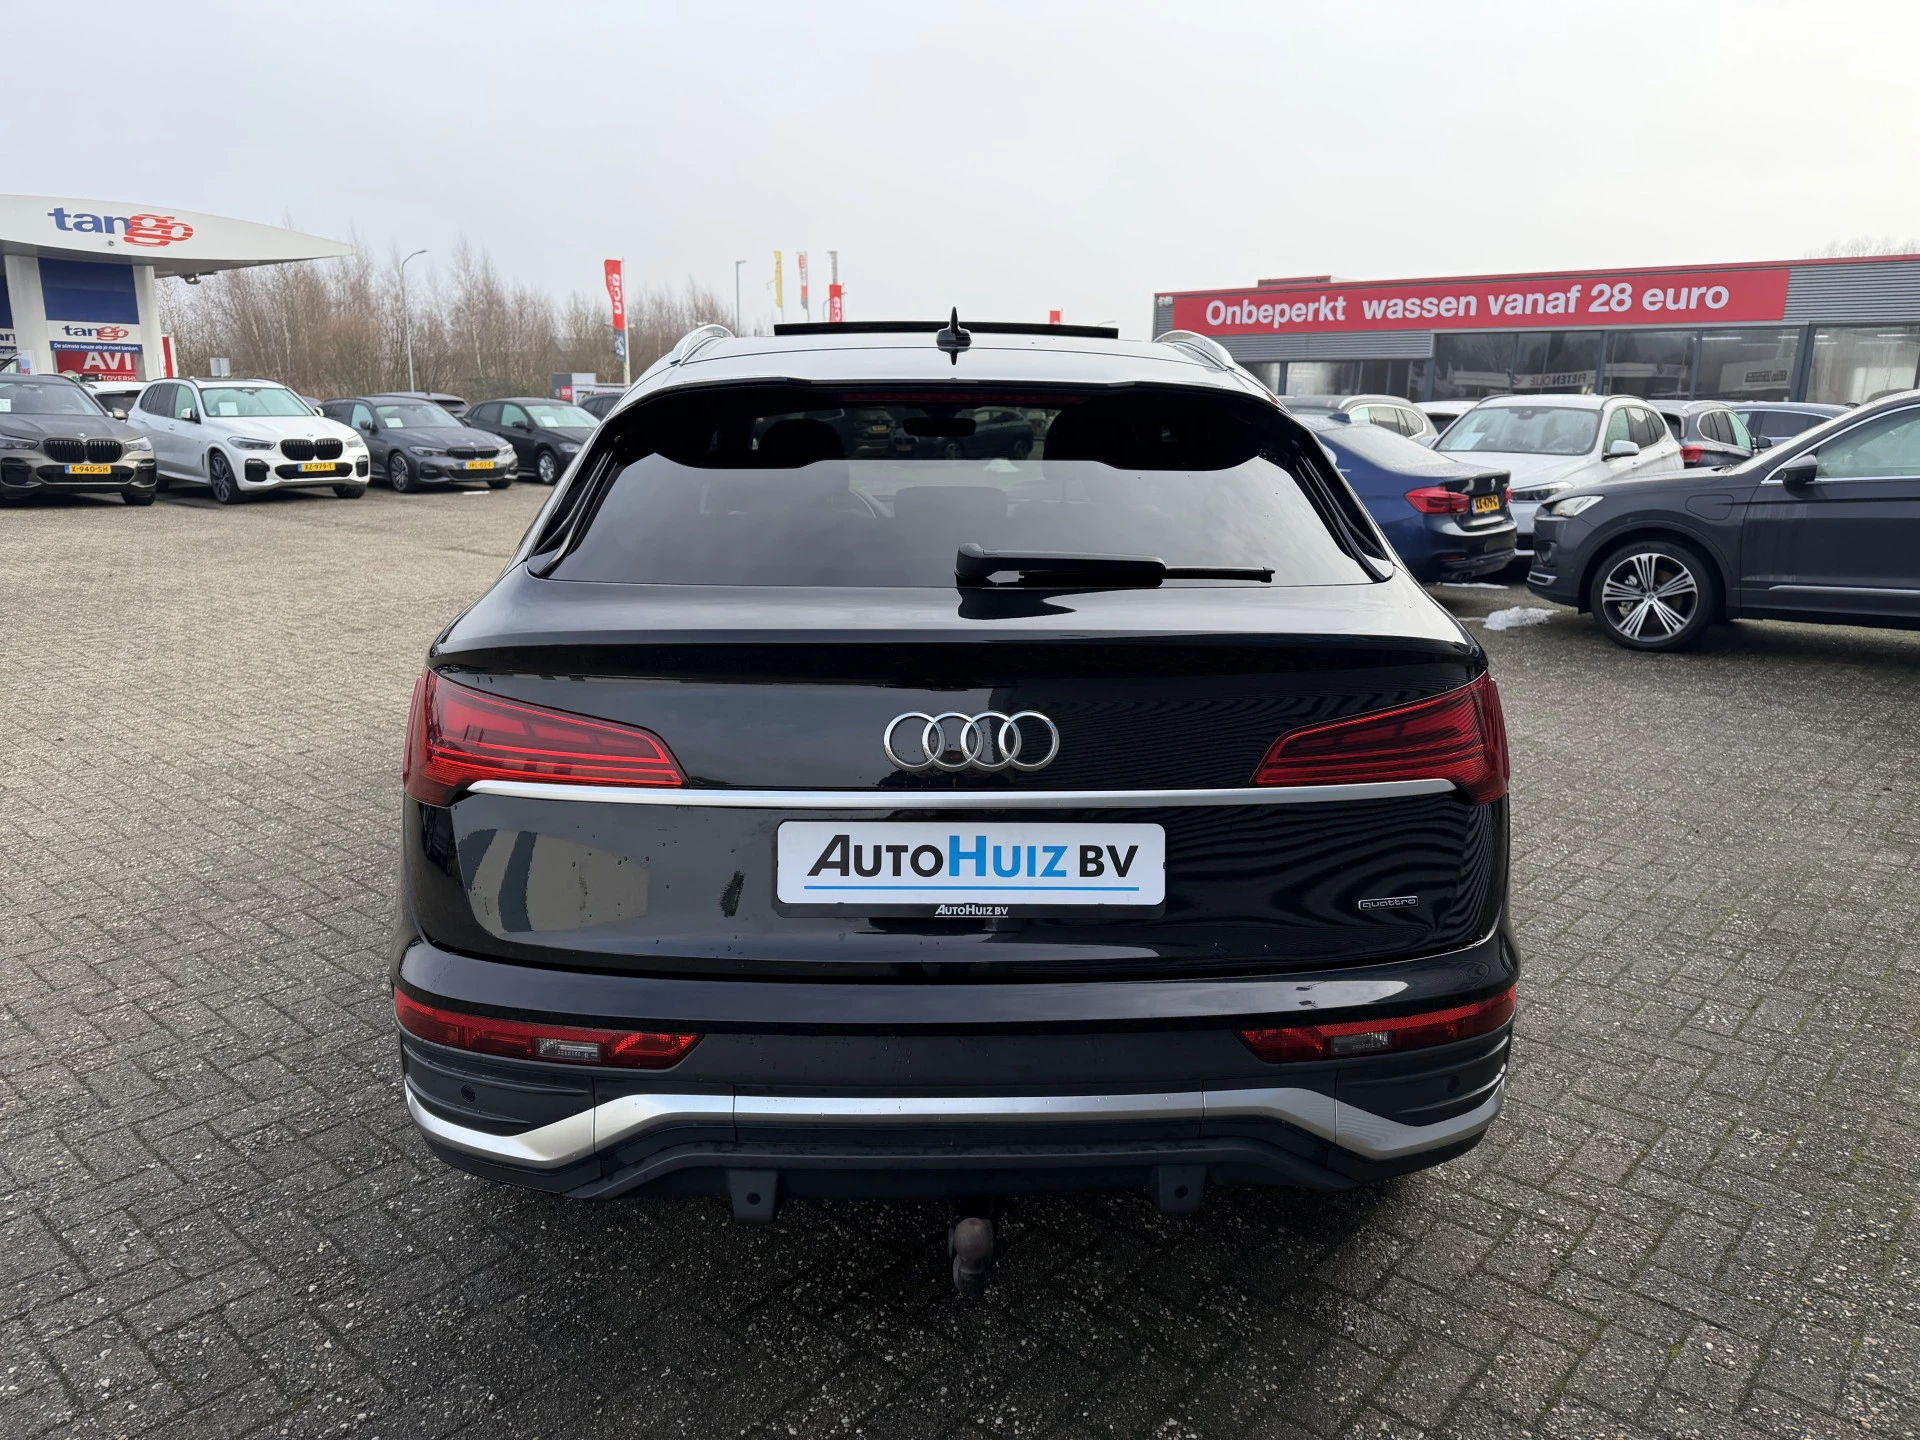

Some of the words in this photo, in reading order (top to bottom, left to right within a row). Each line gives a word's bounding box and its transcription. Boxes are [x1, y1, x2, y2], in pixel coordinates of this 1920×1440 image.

[47, 207, 194, 247] tango
[1205, 295, 1347, 328] Onbeperkt
[1362, 295, 1477, 319] wassen
[1487, 285, 1582, 315] vanaf
[1588, 283, 1633, 313] 28
[1642, 285, 1730, 311] euro
[62, 325, 129, 342] tango
[71, 465, 109, 473] X-940-SH
[1078, 845, 1139, 878] BV
[994, 906, 1009, 915] BV
[1362, 898, 1416, 909] quattro
